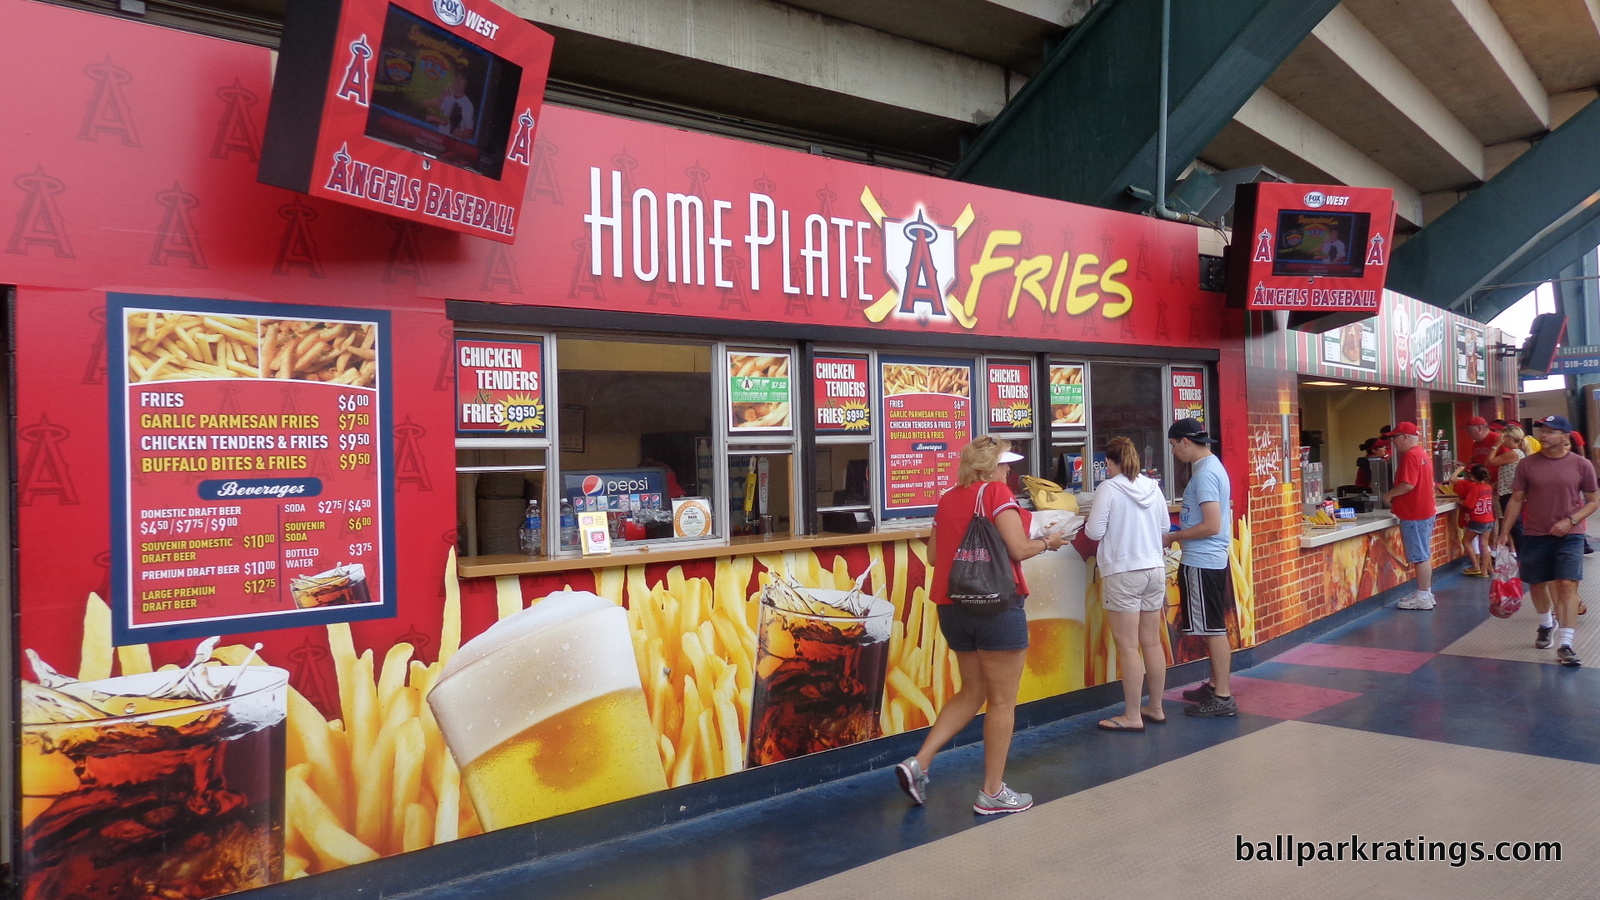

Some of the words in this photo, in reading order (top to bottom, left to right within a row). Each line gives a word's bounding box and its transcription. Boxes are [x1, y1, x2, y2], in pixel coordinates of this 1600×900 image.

[440, 0, 460, 16] FOX
[465, 10, 499, 40] WEST
[324, 141, 421, 211] ANGELS
[423, 183, 515, 237] BASEBALL
[1308, 194, 1321, 202] FOX
[1325, 195, 1350, 206] WEST
[583, 166, 733, 290] HOME
[744, 192, 874, 301] PLATE
[963, 229, 1134, 319] FRIES
[1252, 280, 1308, 306] ANGELS
[1310, 289, 1377, 307] BASEBALL
[460, 346, 522, 368] CHICKEN
[1563, 346, 1598, 355] SECTIONS
[816, 362, 855, 380] CHICKEN
[990, 368, 1020, 383] CHICKEN
[475, 369, 538, 391] TENDERS
[1173, 375, 1196, 388] CHICKEN
[474, 388, 492, 405] &
[825, 381, 866, 398] TENDERS
[997, 384, 1029, 399] TENDERS
[1178, 388, 1202, 401] TENDERS
[140, 392, 184, 408] FRIES
[889, 400, 904, 408] FRIES
[462, 403, 504, 424] FRIES
[817, 407, 844, 424] FRIES
[889, 410, 908, 418] GARLIC
[908, 410, 935, 418] PARMESAN
[935, 410, 949, 418] FRIES
[991, 408, 1012, 422] FRIES
[1174, 408, 1190, 420] FRIES
[140, 414, 196, 429] GARLIC
[200, 414, 278, 429] PARMESAN
[281, 414, 319, 429] FRIES
[889, 421, 912, 429] CHICKEN
[912, 421, 934, 429] TENDERS
[938, 421, 951, 429] FRIES
[141, 435, 208, 451] CHICKEN
[211, 435, 275, 450] TENDERS
[278, 436, 288, 449] &
[290, 435, 328, 449] FRIES
[890, 431, 912, 440] BUFFALO
[912, 431, 927, 439] BITES
[931, 431, 944, 439] FRIES
[916, 443, 943, 451] Beverages
[142, 457, 208, 473] BUFFALO
[211, 456, 253, 471] BITES
[255, 456, 266, 470] &
[268, 455, 307, 470] FRIES
[217, 481, 306, 498] Beverages
[607, 477, 649, 494] pepsi
[141, 508, 190, 519] DOMESTIC
[190, 507, 217, 518] DRAFT
[219, 506, 242, 517] BEER
[284, 503, 306, 513] SODA
[285, 521, 326, 532] SOUVENIR
[141, 540, 187, 552] SOUVENIR
[188, 538, 233, 550] DOMESTIC
[285, 532, 308, 543] SODA
[141, 553, 172, 564] DRAFT
[173, 551, 197, 562] BEER
[285, 547, 319, 558] BOTTLED
[286, 558, 314, 569] WATER
[142, 568, 185, 581] PREMIUM
[187, 567, 215, 578] DRAFT
[217, 565, 240, 576] BEER
[142, 590, 172, 601] LARGE
[174, 585, 216, 598] PREMIUM
[142, 602, 172, 613] DRAFT
[174, 599, 197, 610] BEER
